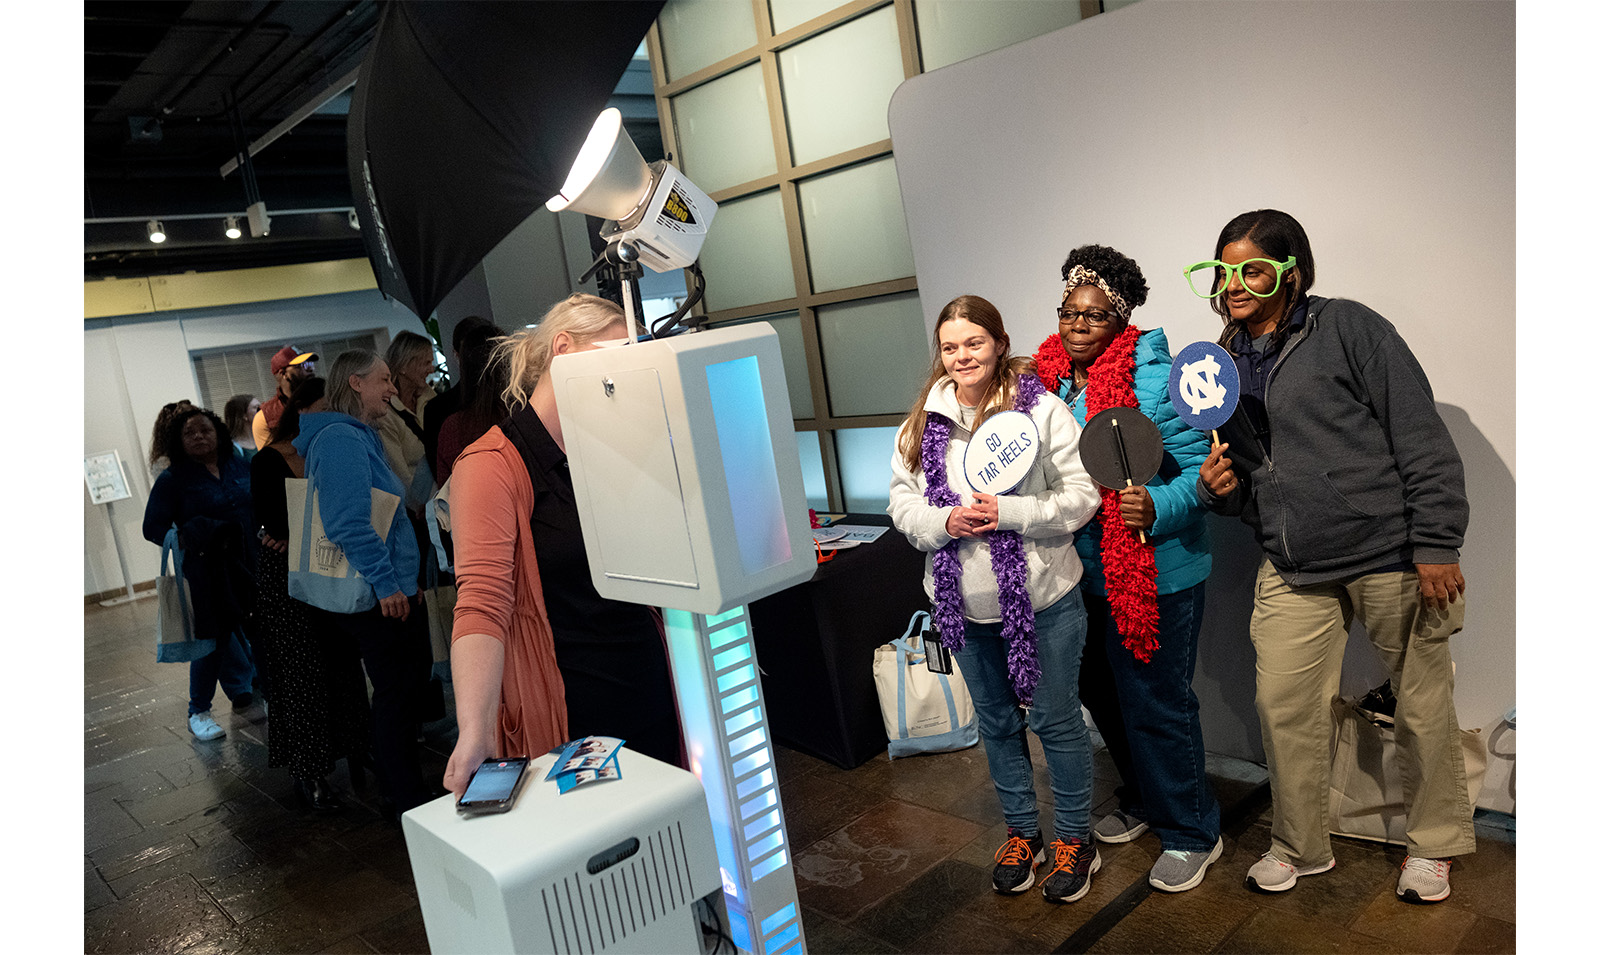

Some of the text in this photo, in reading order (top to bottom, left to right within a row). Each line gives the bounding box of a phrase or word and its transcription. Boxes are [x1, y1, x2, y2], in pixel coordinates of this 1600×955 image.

[666, 199, 688, 222] B800
[985, 432, 1001, 452] GO
[978, 432, 1032, 485] TAR HEELS
